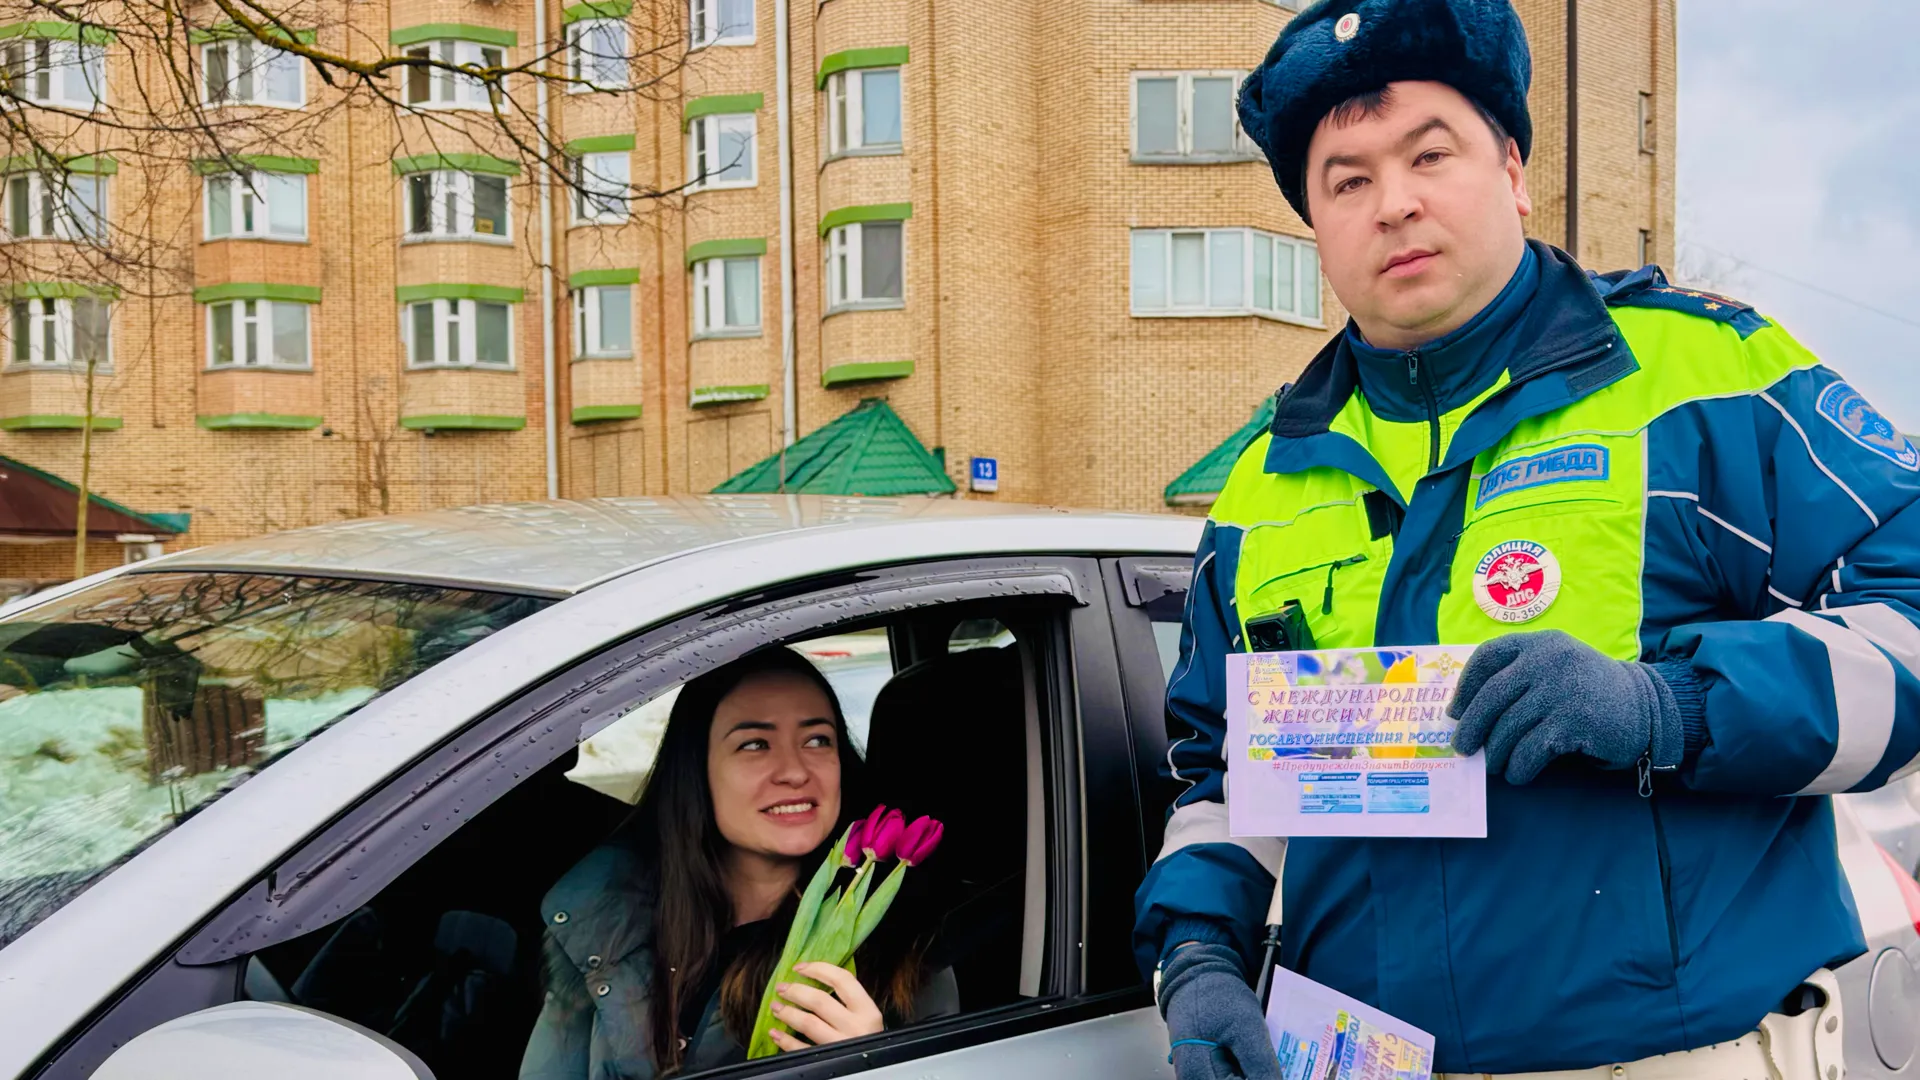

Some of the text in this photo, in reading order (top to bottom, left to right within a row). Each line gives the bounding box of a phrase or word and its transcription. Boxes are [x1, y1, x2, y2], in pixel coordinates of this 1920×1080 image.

[979, 462, 993, 478] 13
[1482, 451, 1598, 496] ДПС ГИБДД
[1477, 541, 1543, 575] ПОЛИЦИЯ
[1505, 588, 1535, 608] ДПС
[1502, 600, 1547, 621] 50-3561
[1248, 690, 1261, 706] С
[1262, 706, 1444, 725] ЖЕНСКИМ ДНЕМ!
[1248, 732, 1404, 746] ГОСАВТОИНСПЕКЦИЯ
